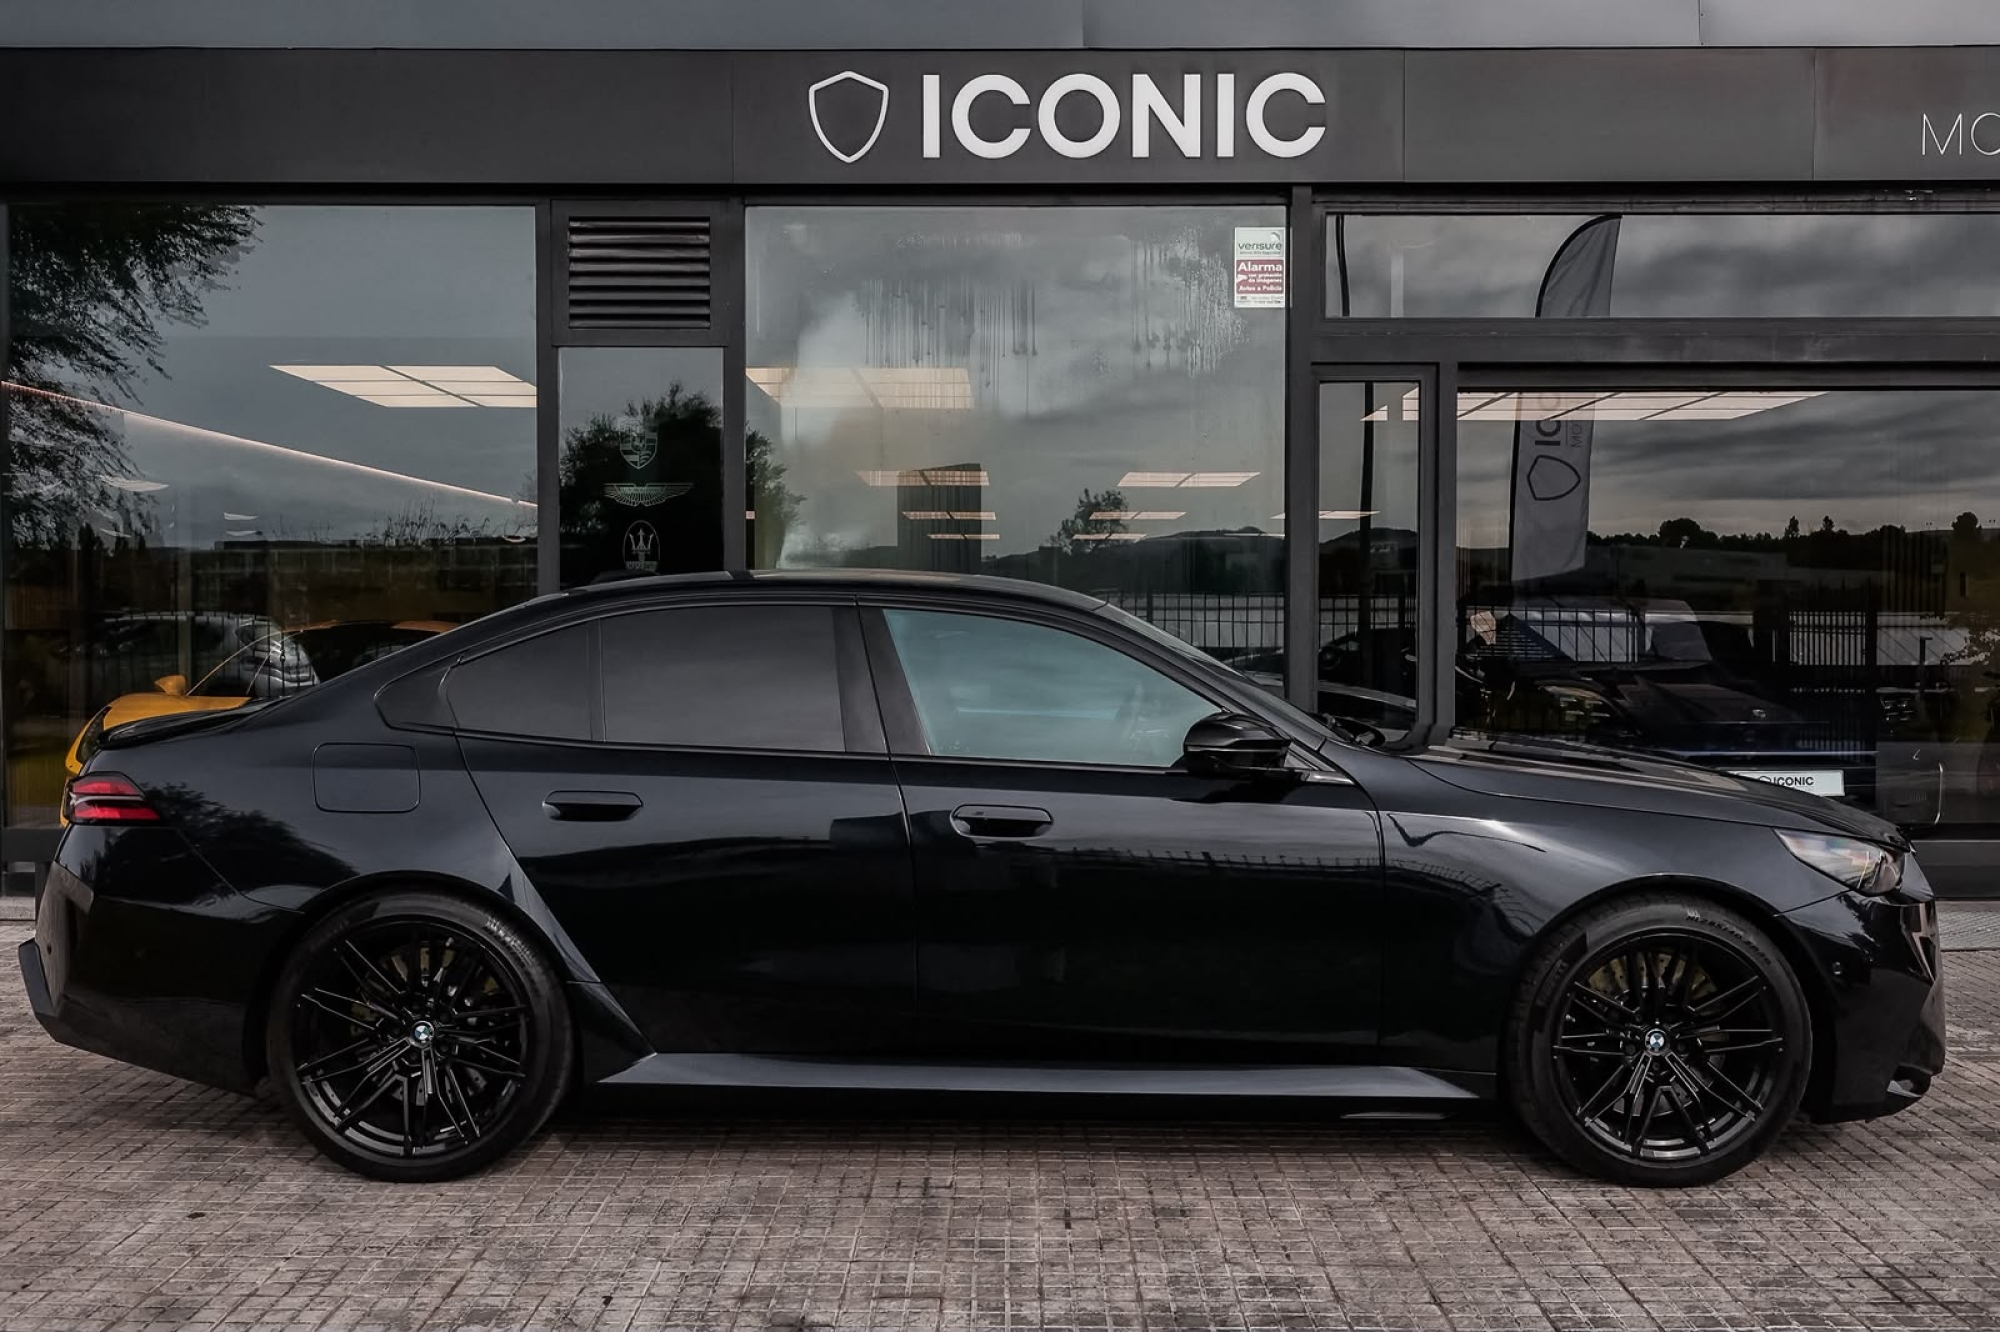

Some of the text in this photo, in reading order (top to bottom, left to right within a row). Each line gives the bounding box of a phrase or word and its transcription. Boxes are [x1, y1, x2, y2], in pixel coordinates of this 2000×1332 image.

[922, 72, 1327, 159] ICONIC
[1238, 242, 1282, 250] verisure
[1238, 261, 1282, 271] Alarma
[1773, 777, 1814, 786] ICONIC
